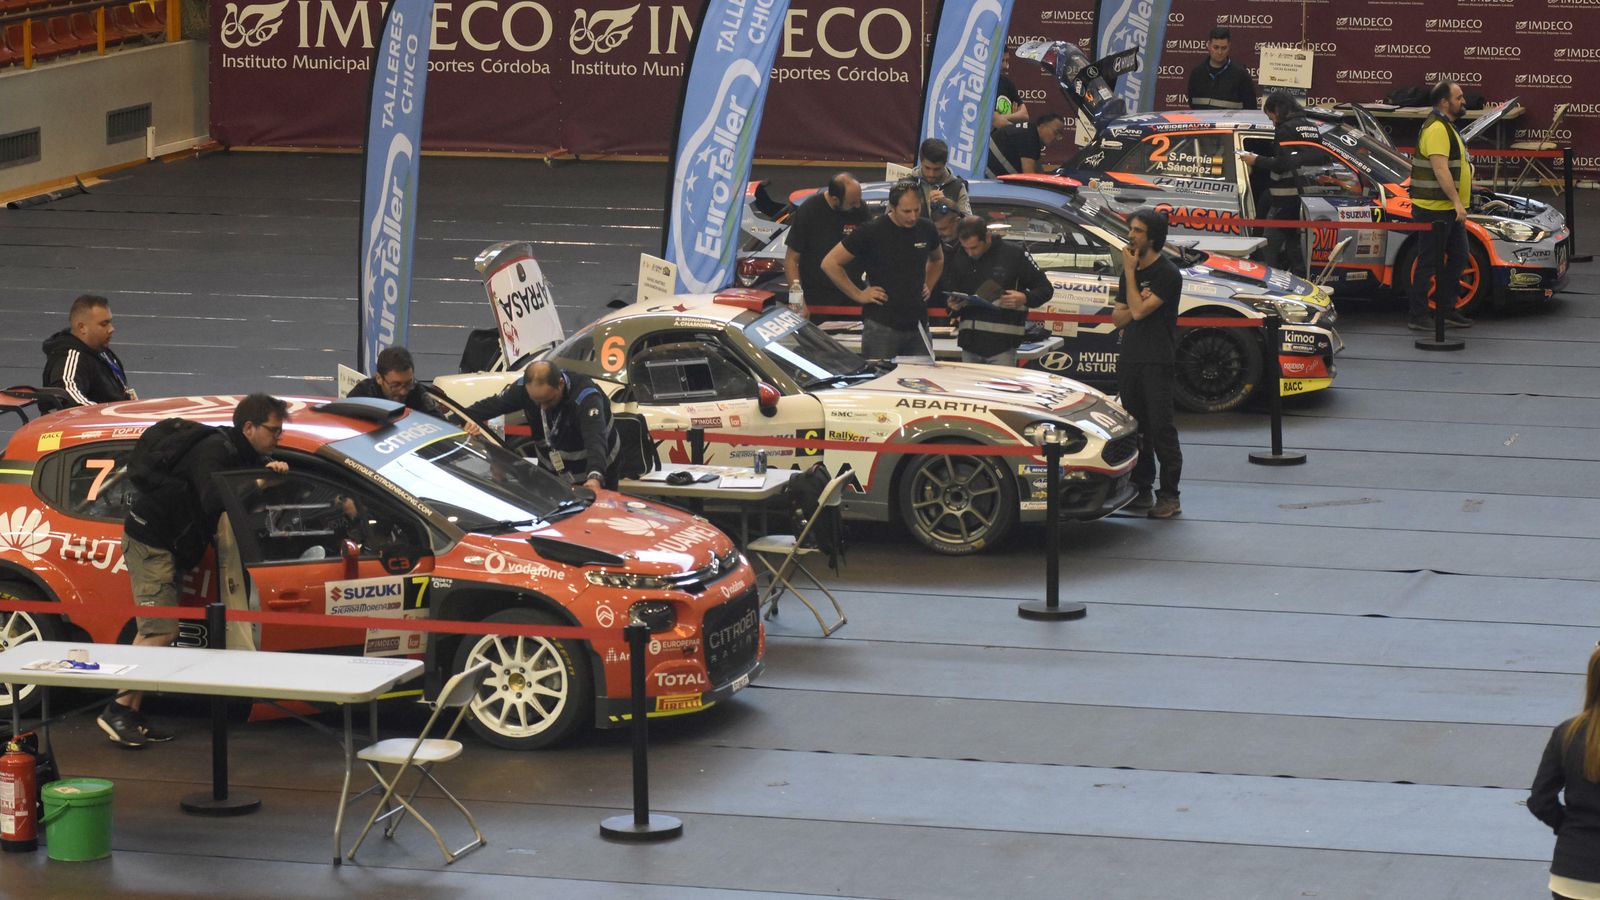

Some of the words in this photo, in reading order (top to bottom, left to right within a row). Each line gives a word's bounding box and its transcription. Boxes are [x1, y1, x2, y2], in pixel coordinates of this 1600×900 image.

[747, 0, 774, 44] CHIC
[1229, 14, 1273, 24] IMDECO
[1349, 17, 1393, 27] IMDECO
[1438, 19, 1483, 29] IMDECO
[298, 0, 553, 51] IMECO
[716, 0, 746, 52] TALLE
[1528, 21, 1573, 31] IMDECO
[1006, 36, 1047, 45] MDECO
[1179, 40, 1209, 50] IMDE
[1267, 42, 1301, 50] IMDEC
[1307, 43, 1337, 52] DECO
[1387, 45, 1431, 54] IMDECO
[1476, 46, 1521, 56] IMDECO
[1567, 48, 1600, 58] IMDEC
[222, 54, 287, 70] Instituto
[292, 55, 370, 73] Municipal
[427, 57, 475, 74] portes
[481, 57, 551, 75] Córdoba
[382, 10, 404, 128] TALLERES
[402, 34, 418, 114] CHICO
[571, 60, 637, 76] Instituto
[769, 65, 831, 83] eportes
[837, 66, 909, 83] Córdoba
[1349, 70, 1393, 80] IMDECO
[1527, 74, 1572, 84] IMDECO
[950, 27, 991, 171] EuroTaller
[1018, 90, 1047, 99] DECO
[1566, 103, 1600, 113] IMDEC
[1149, 136, 1171, 162] 2
[1169, 152, 1212, 164] S.Pernía
[1156, 161, 1211, 174] A.Sánchez
[694, 94, 748, 259] EuroTaller
[1175, 180, 1235, 193] HYUNDAI
[1345, 210, 1371, 219] SUZUKI
[1053, 281, 1108, 294] SUZUKI
[1285, 331, 1315, 343] kimoa
[600, 336, 625, 373] 6
[1079, 352, 1119, 362] HYUN
[1283, 382, 1303, 391] RACC
[896, 398, 988, 413] ABARTH
[829, 431, 870, 443] Rallycar
[86, 459, 115, 501] 7
[388, 557, 410, 571] C3
[508, 562, 566, 581] vodafone
[344, 584, 402, 600] SUZUKI
[412, 577, 430, 608] 7
[654, 672, 706, 687] TOTAL
